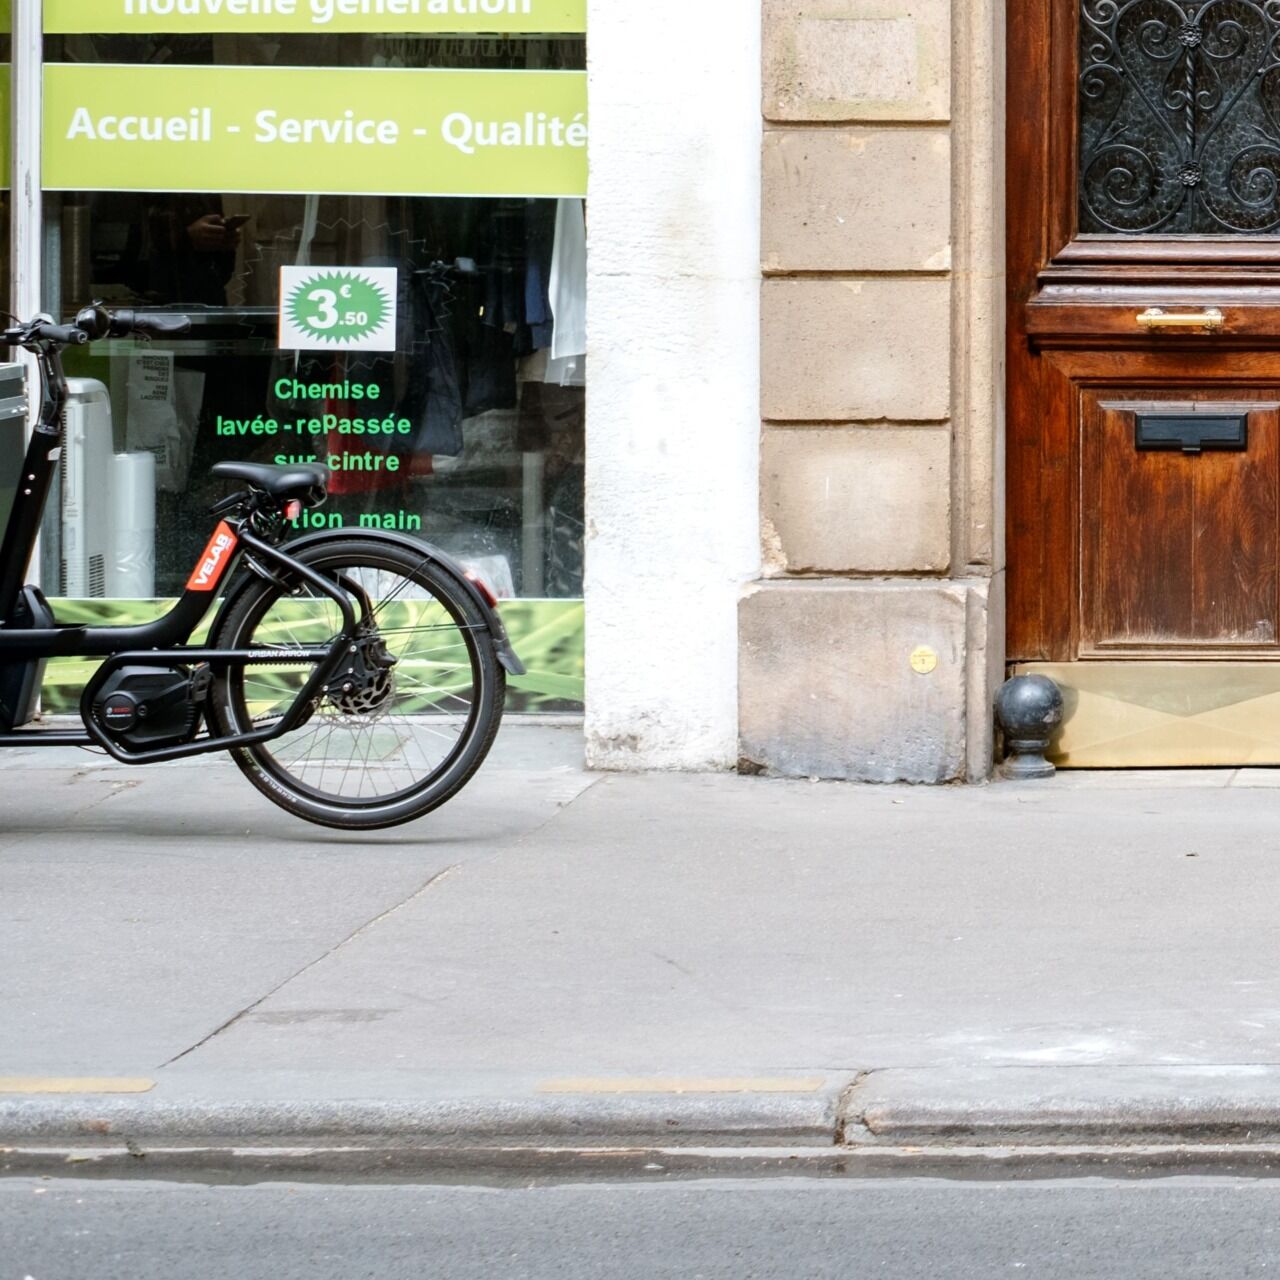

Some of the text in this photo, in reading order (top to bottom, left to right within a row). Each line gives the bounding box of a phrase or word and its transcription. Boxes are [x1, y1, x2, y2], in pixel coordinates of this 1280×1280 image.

[66, 107, 212, 143] Accueil
[254, 109, 399, 144] Service
[441, 111, 588, 154] Qualité
[274, 378, 381, 399] Chemise
[327, 450, 400, 471] cintre
[359, 510, 421, 529] main
